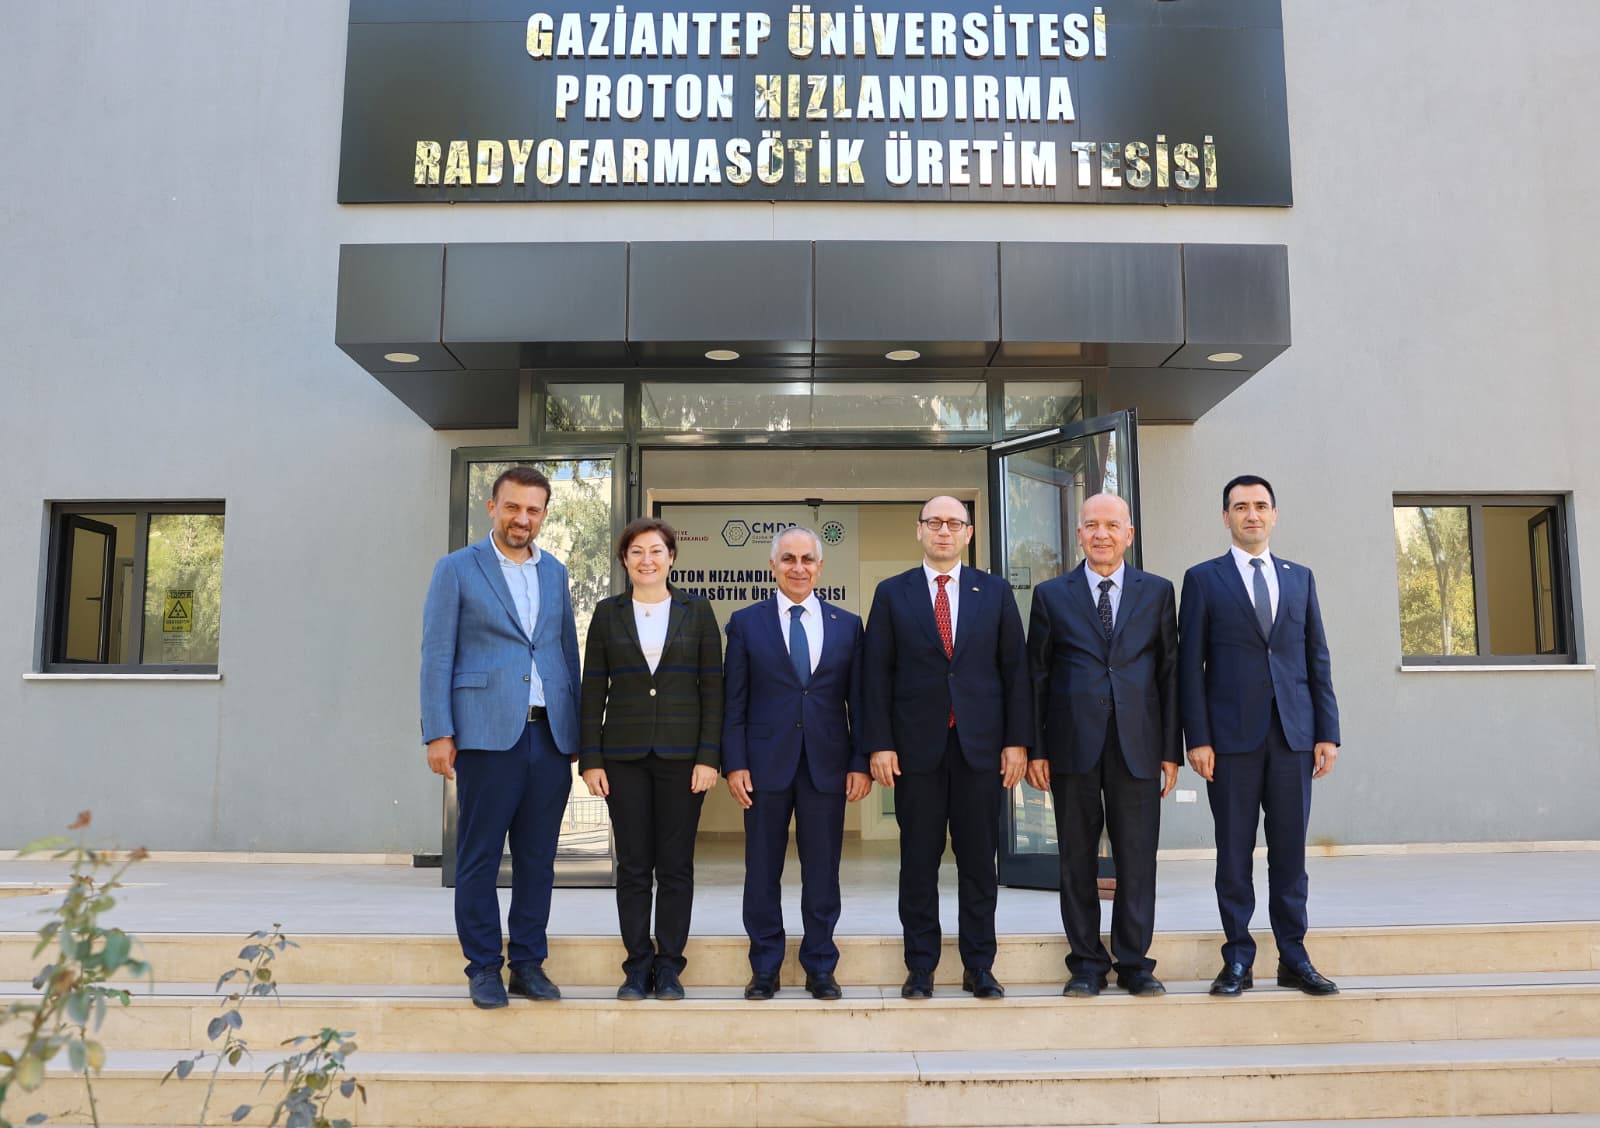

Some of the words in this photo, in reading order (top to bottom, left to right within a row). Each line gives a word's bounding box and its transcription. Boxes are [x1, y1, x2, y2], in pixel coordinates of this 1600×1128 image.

[526, 5, 771, 60] GAZİANTEP
[787, 4, 1107, 60] ÜNİVERSİTESİ
[555, 74, 733, 121] PROTON
[754, 74, 1076, 122] HIZLANDIRMA
[414, 130, 865, 187] RADYOFARMASÖTİK
[885, 130, 1057, 187] ÜRETİM
[1071, 134, 1218, 190] TESİSİ
[671, 570, 704, 583] OTON
